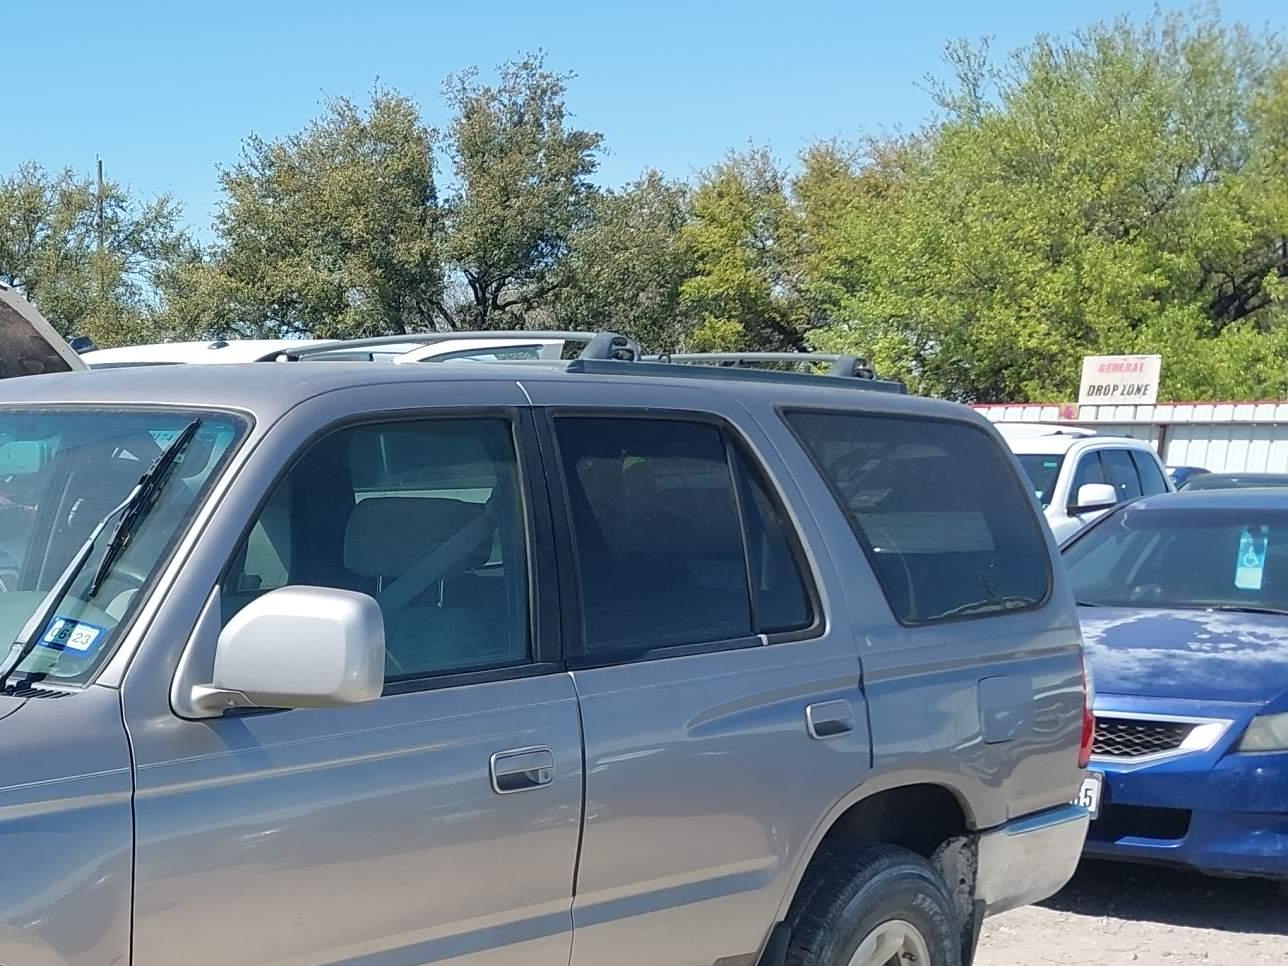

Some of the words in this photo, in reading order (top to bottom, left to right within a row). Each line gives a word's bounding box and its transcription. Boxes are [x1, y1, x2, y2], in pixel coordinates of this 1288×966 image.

[1098, 361, 1145, 374] GENERAL
[1087, 383, 1120, 397] DROP
[1120, 383, 1151, 396] ZONE
[71, 632, 92, 645] 23
